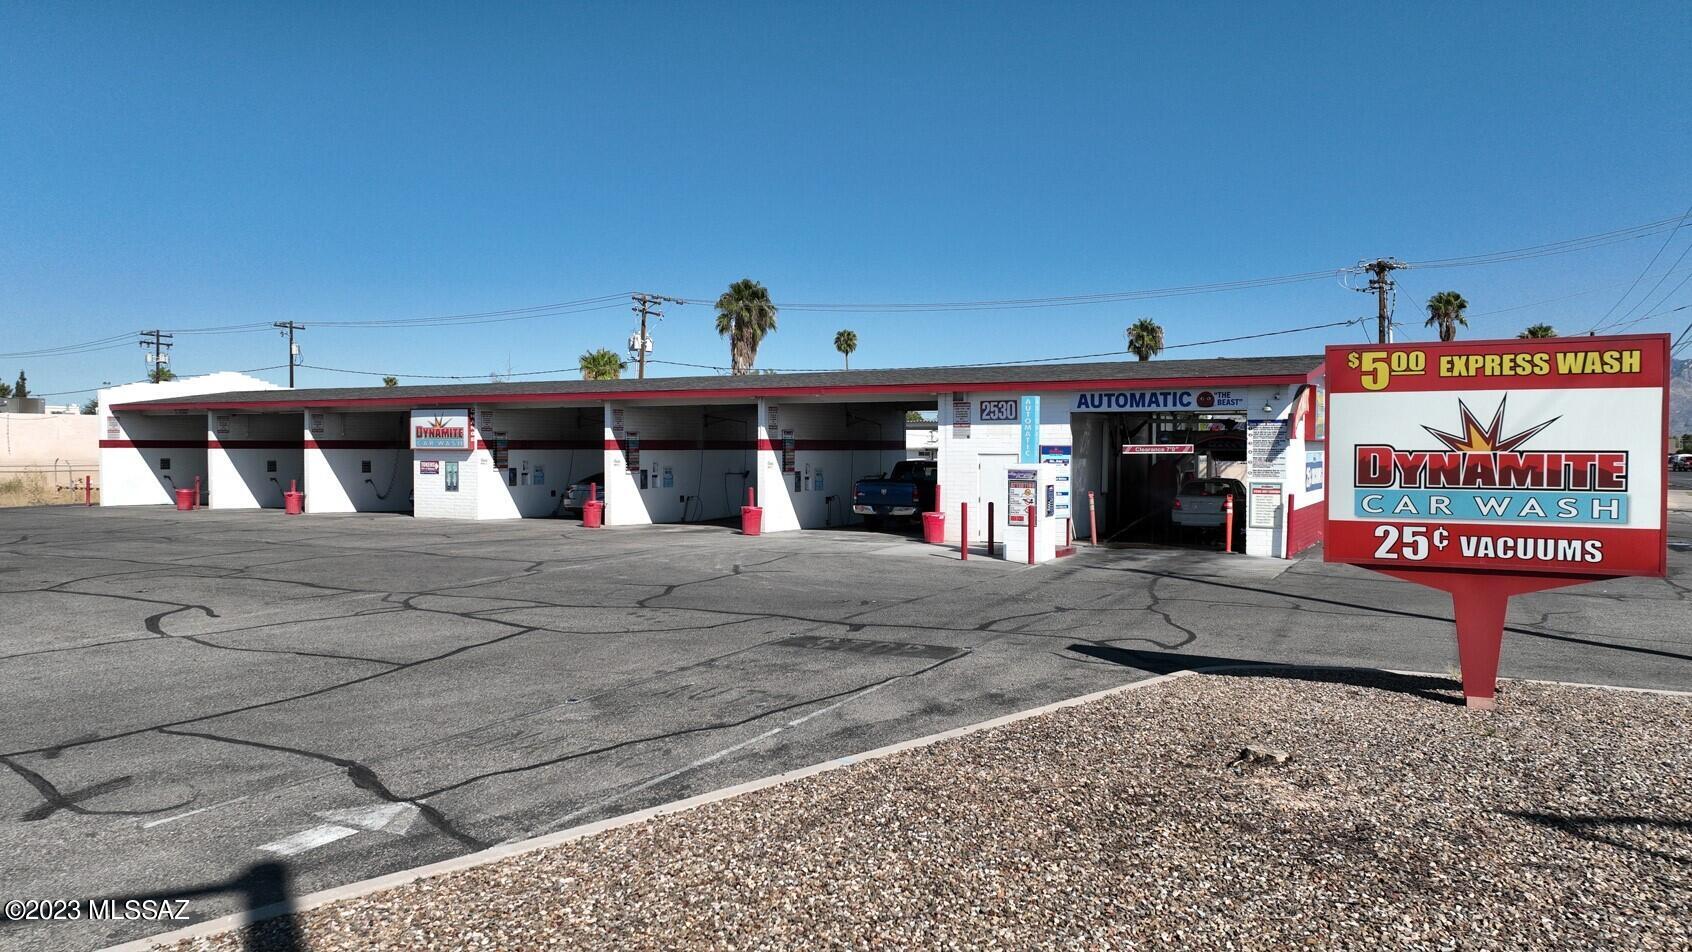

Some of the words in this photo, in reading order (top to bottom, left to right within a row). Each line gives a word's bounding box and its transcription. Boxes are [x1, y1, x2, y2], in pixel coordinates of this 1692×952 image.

[1439, 352, 1550, 377] EXPRESS
[1555, 349, 1642, 375] WASH
[981, 401, 1016, 420] 2530
[1077, 391, 1192, 408] AUTOMATIC
[415, 426, 464, 439] DYNAMITE
[1024, 399, 1032, 456] AUTOMATIC
[1354, 443, 1629, 491] DYNAMITE
[1361, 494, 1453, 515] CAR
[1472, 495, 1619, 519] WASH
[1373, 524, 1449, 561] 25¢
[1459, 535, 1603, 563] VACUUMS
